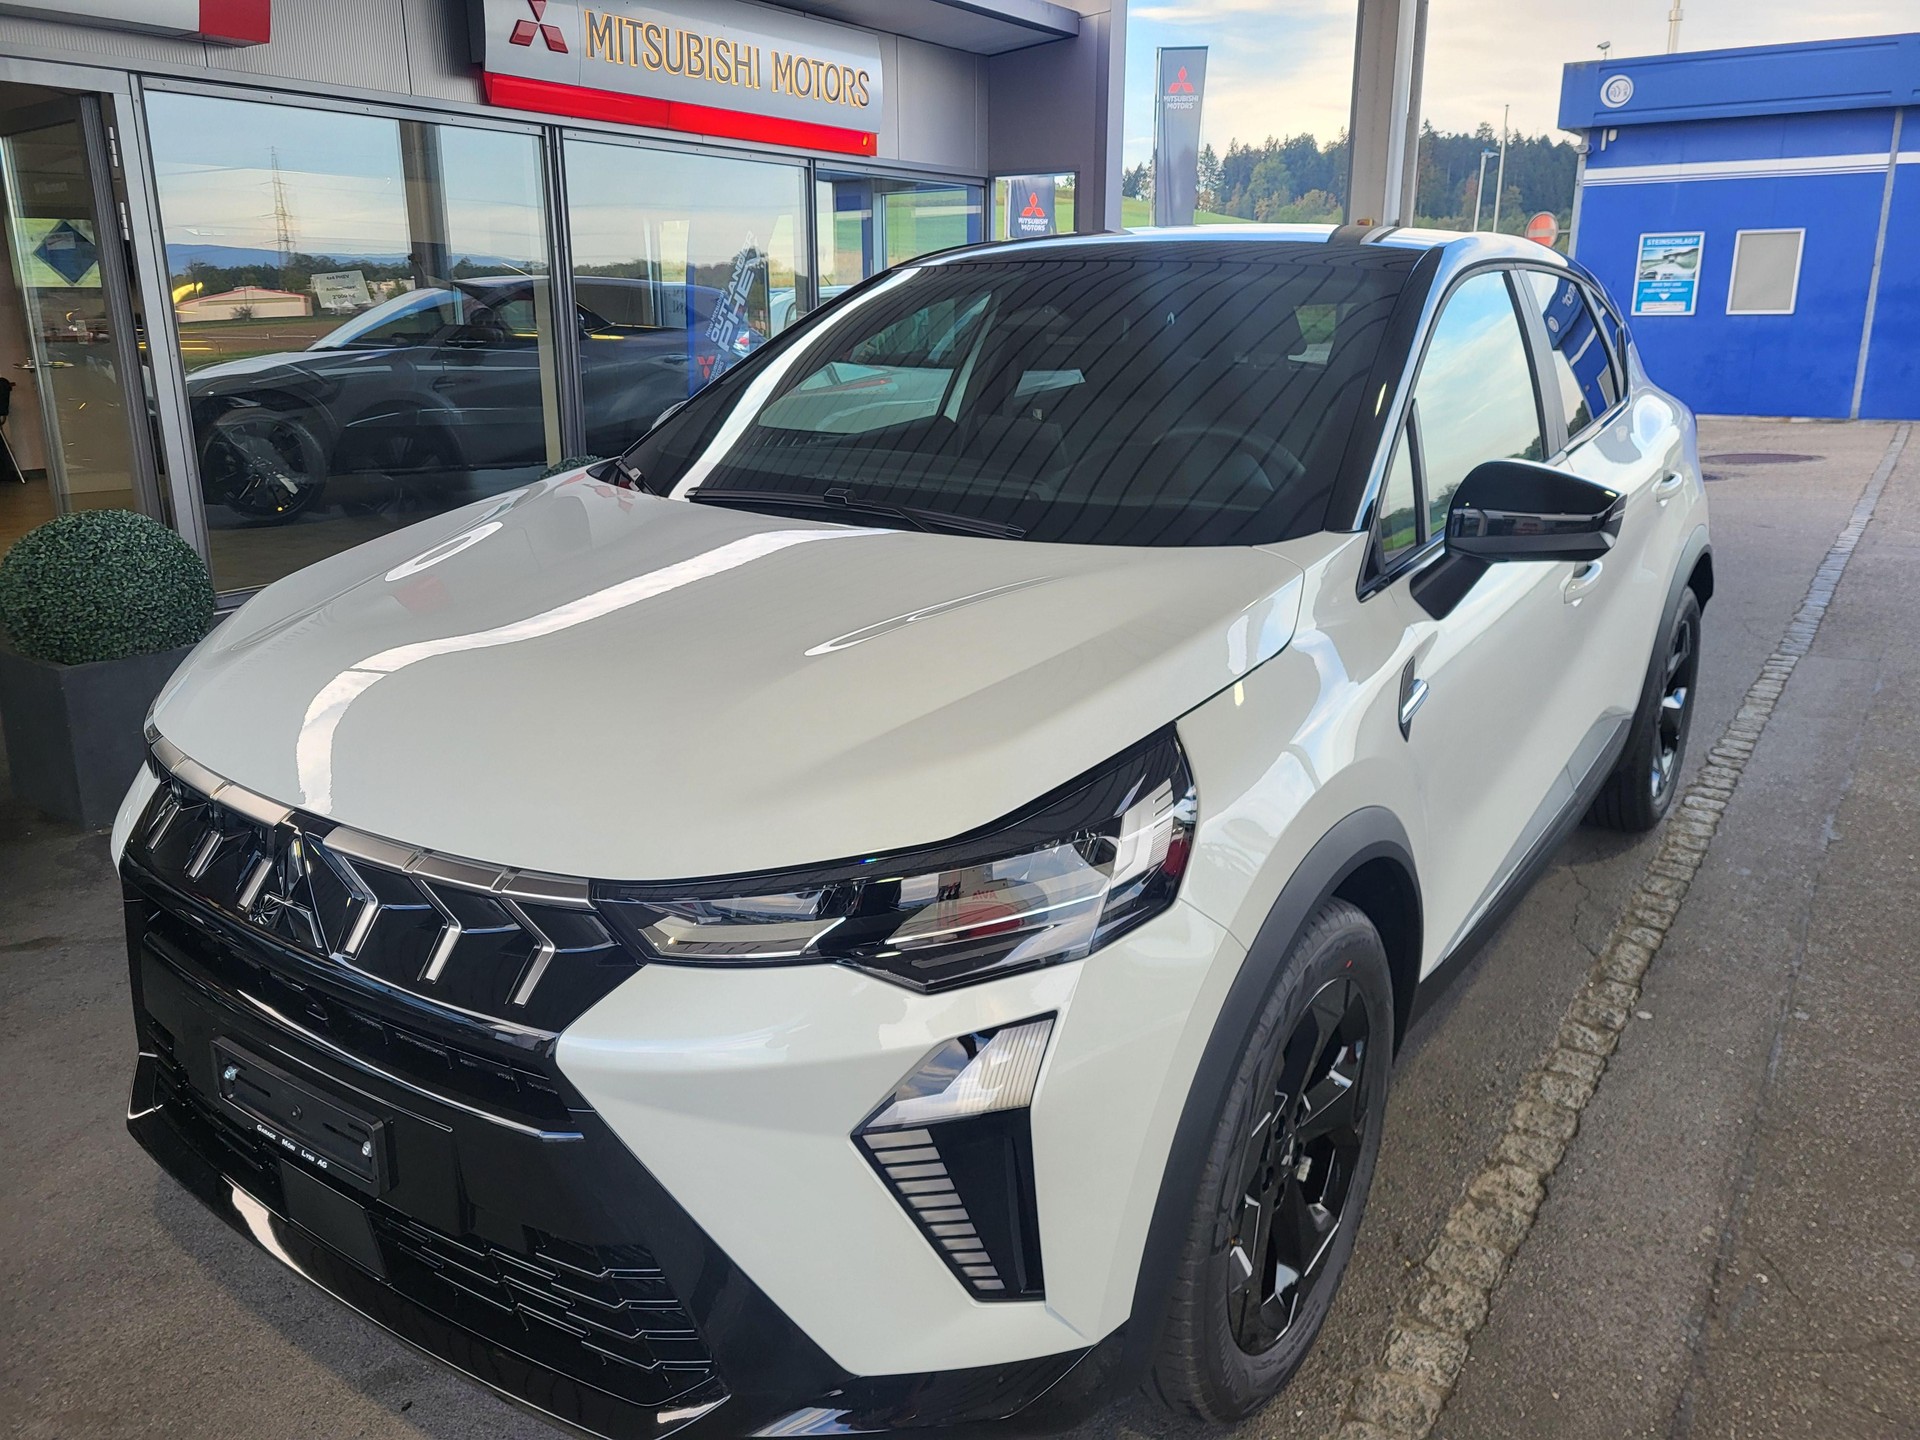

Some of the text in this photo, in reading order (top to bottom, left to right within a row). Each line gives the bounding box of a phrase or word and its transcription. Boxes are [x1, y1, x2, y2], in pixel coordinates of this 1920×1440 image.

[584, 9, 871, 108] MITSUBISHI MOTORS
[1163, 95, 1199, 103] MITSUBISHI
[1166, 102, 1194, 110] MOTORS
[710, 229, 756, 343] OUTLANDER
[717, 234, 764, 353] PHEV
[317, 1159, 328, 1168] AG
